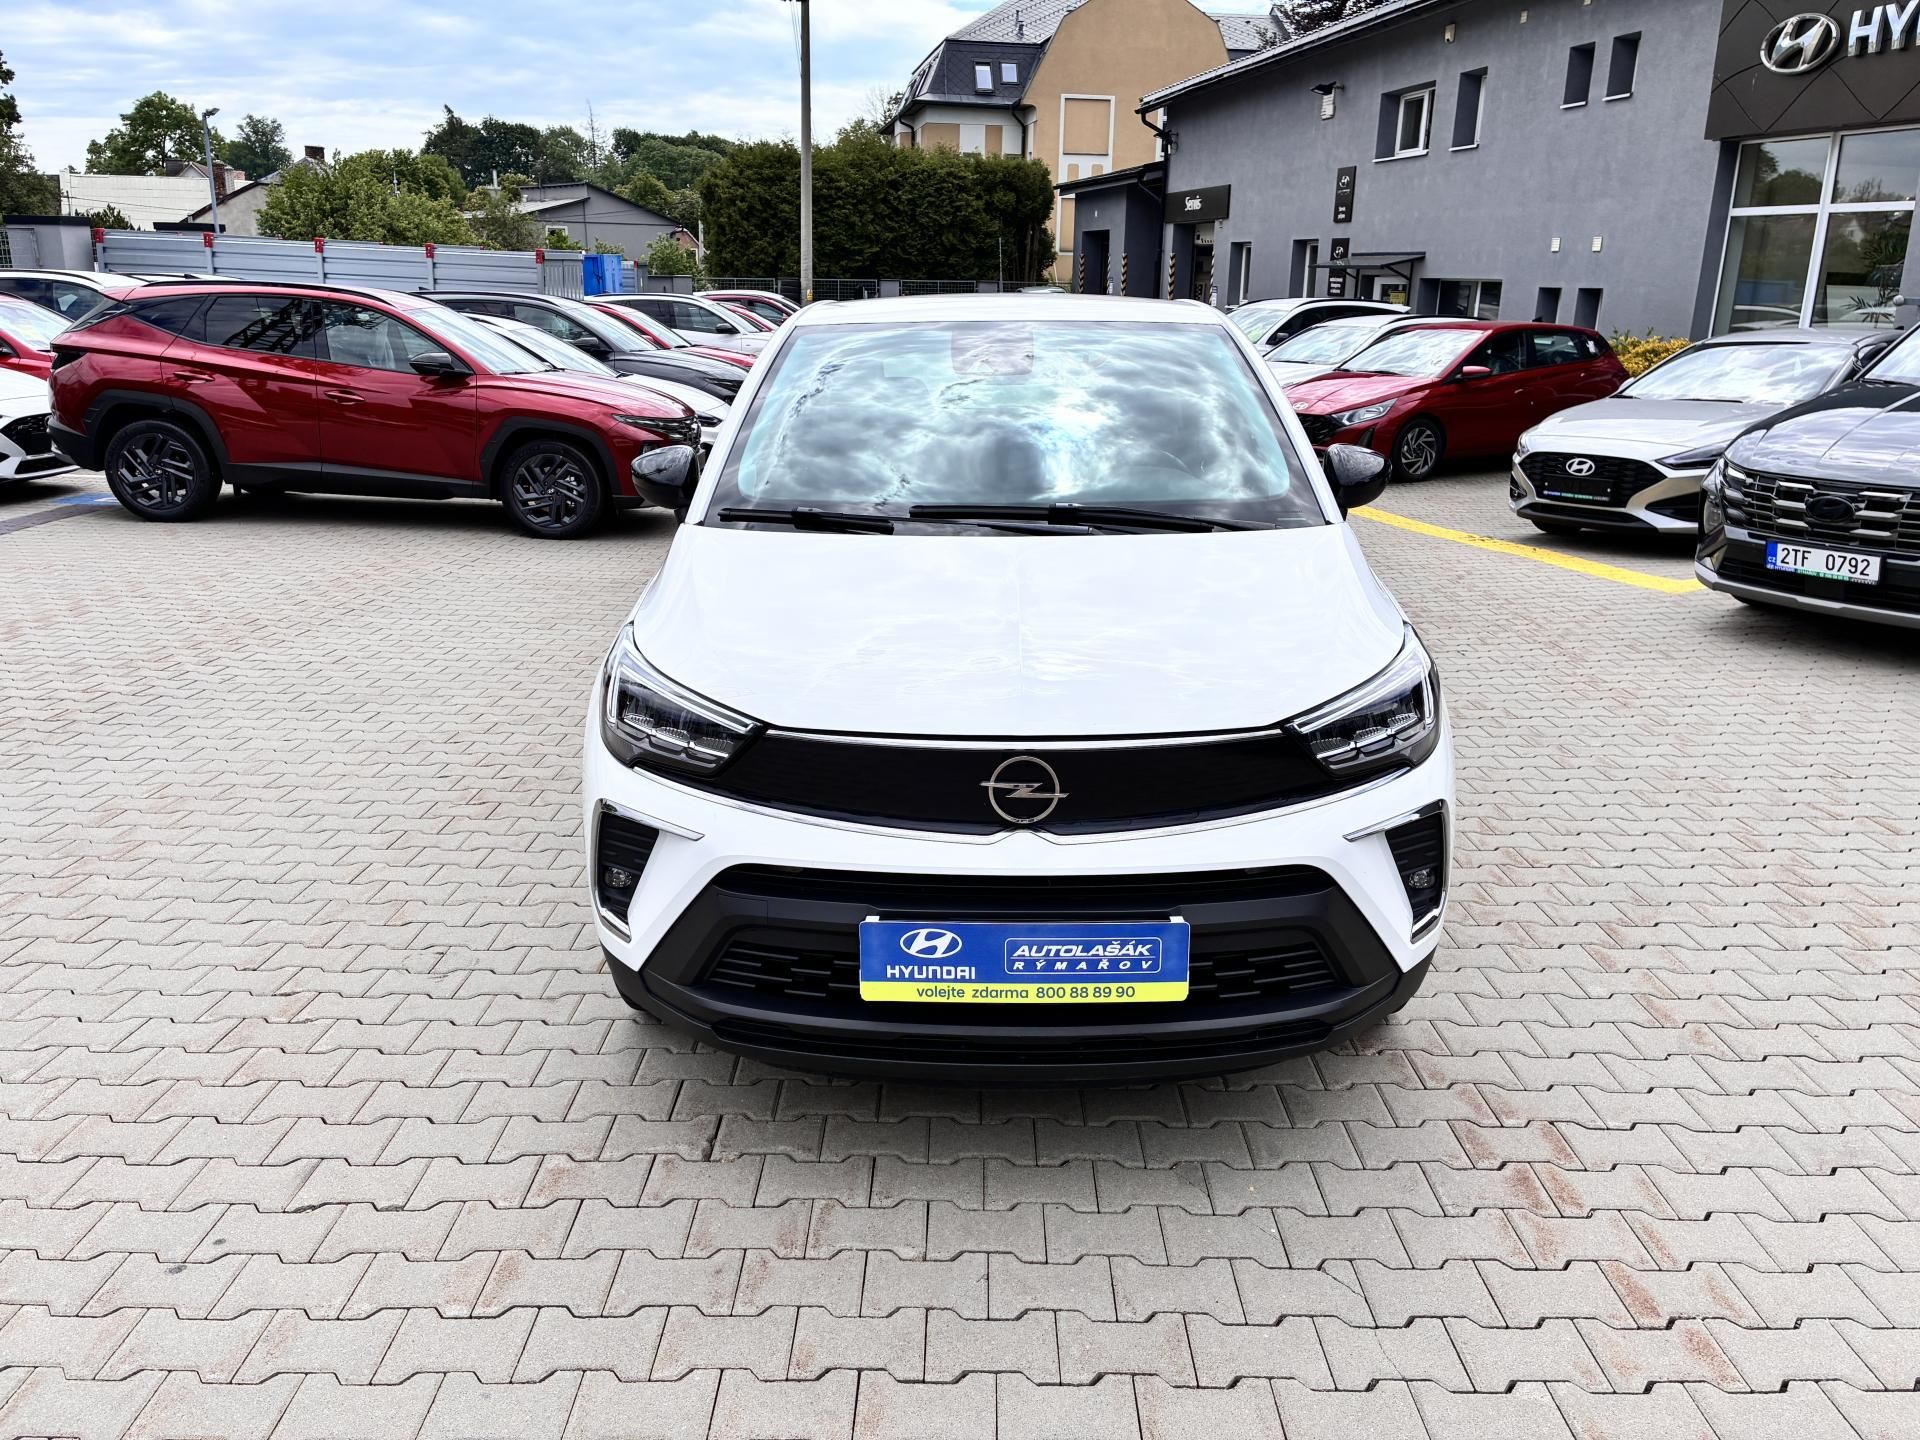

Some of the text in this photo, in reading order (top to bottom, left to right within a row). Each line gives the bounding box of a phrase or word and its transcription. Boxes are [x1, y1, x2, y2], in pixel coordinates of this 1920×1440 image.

[1848, 0, 1920, 57] HY
[1767, 556, 1776, 564] CZ
[1780, 547, 1812, 567] 2TF
[1825, 554, 1871, 576] 0792
[1012, 940, 1153, 957] AUTOLAŠÁK
[886, 964, 976, 980] HYUNDAI
[916, 985, 1136, 1000] volejte zdarma 800 88 89 90
